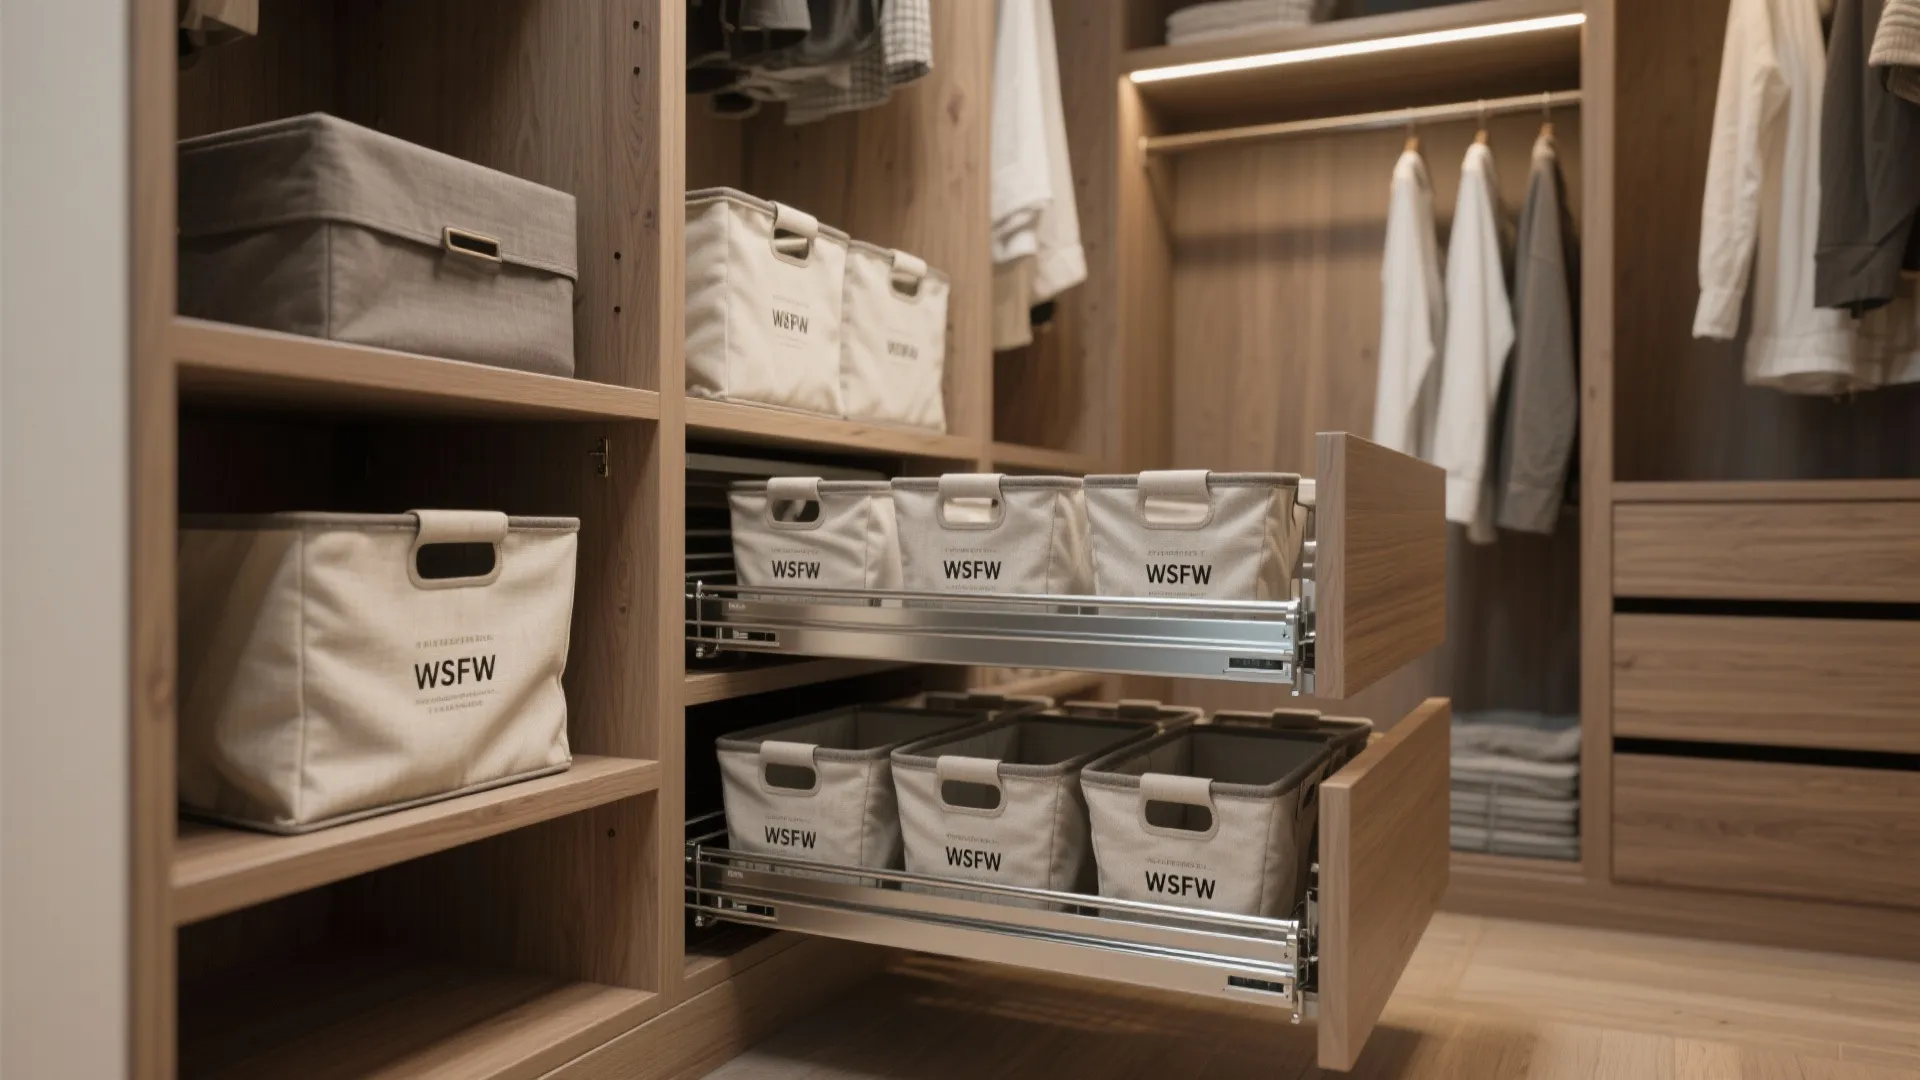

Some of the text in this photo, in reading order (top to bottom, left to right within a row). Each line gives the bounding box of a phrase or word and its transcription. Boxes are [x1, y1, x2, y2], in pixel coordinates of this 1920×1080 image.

[771, 560, 821, 579] WSFW
[943, 560, 1002, 580] WSFW
[1145, 563, 1212, 585] WSFW
[414, 654, 496, 690] WSFW
[764, 825, 817, 849] WSFW
[945, 845, 1002, 872] WSFW
[1145, 870, 1216, 900] WSFW
